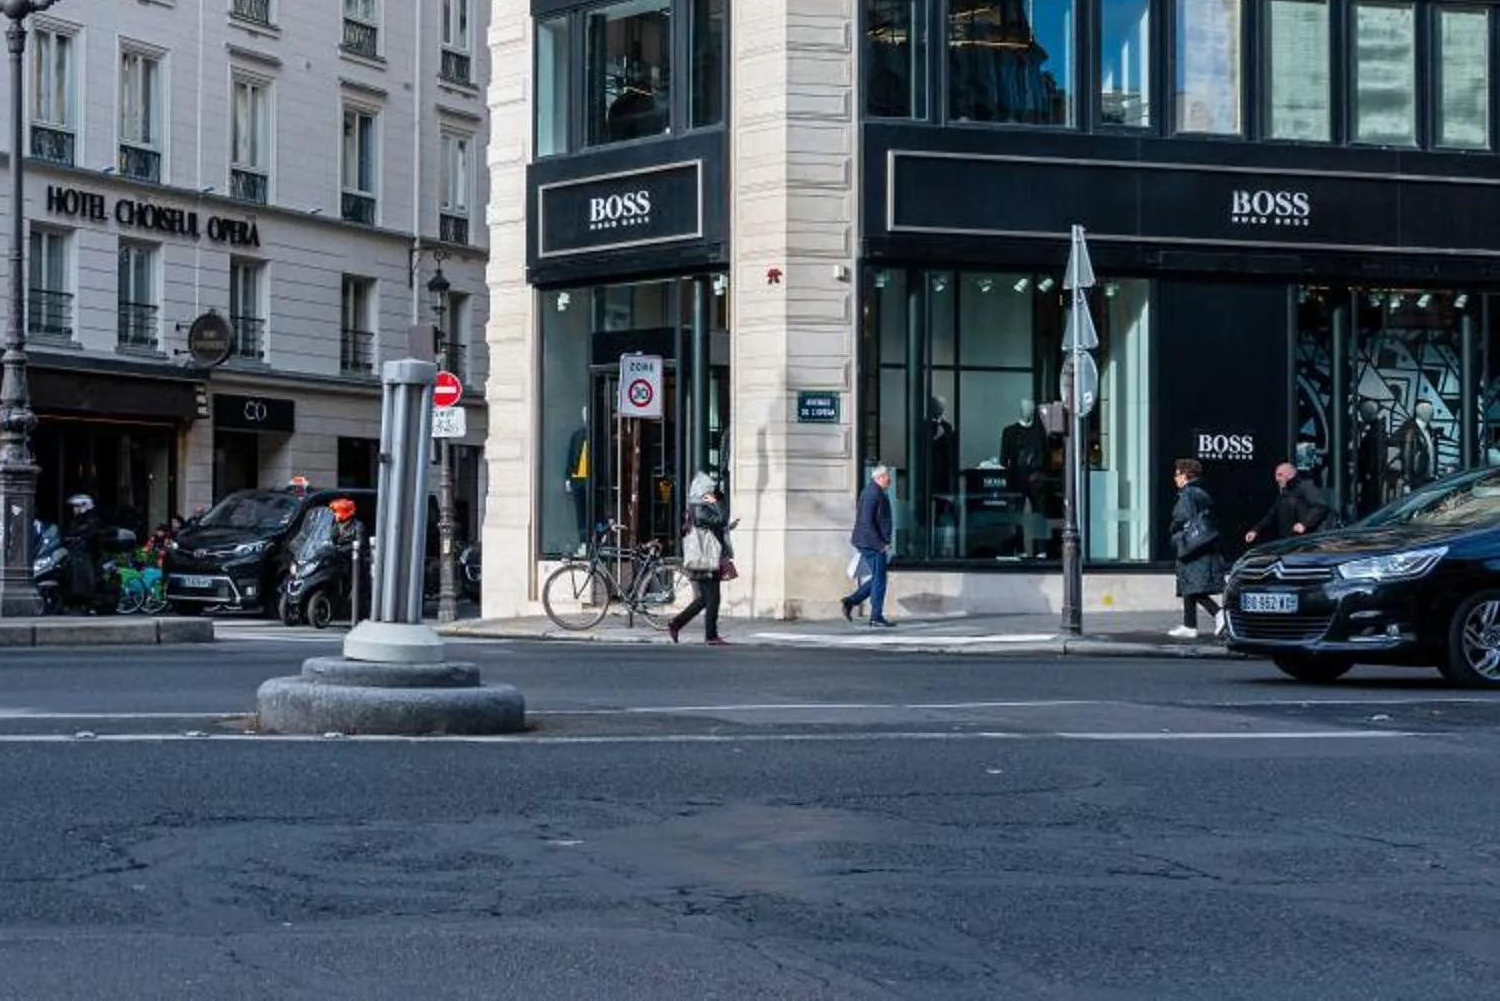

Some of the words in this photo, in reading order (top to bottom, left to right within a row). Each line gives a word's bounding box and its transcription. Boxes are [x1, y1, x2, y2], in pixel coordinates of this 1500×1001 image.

[47, 185, 108, 222] HOTEL
[116, 199, 200, 242] CHOISEUL
[590, 190, 651, 222] BOSS
[1232, 190, 1310, 217] BOSS
[1199, 434, 1253, 454] BOSS
